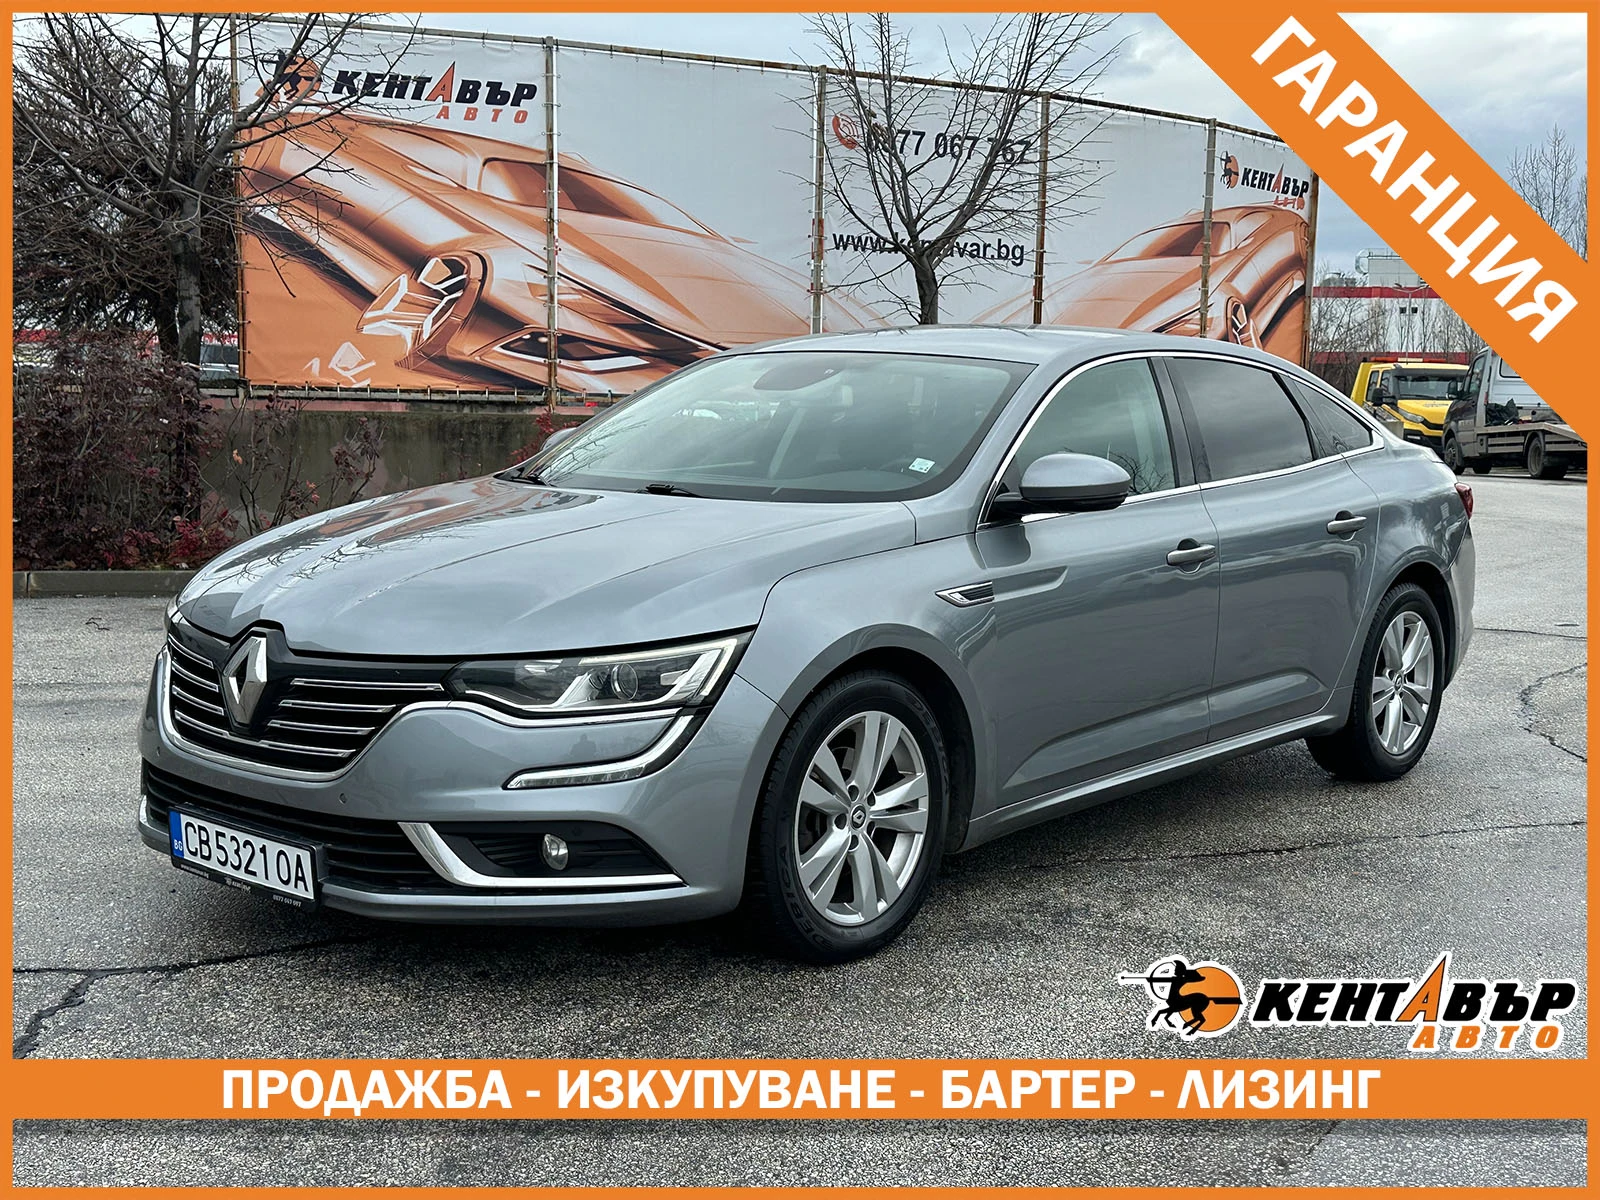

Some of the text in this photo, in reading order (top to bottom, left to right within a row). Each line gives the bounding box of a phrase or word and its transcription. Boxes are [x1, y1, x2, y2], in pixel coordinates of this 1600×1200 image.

[332, 61, 538, 107] КЕНТАВЪР
[436, 105, 528, 123] АВТО
[934, 132, 979, 160] 067
[1241, 163, 1309, 198] КЕНТАВЪР
[173, 839, 183, 851] BG
